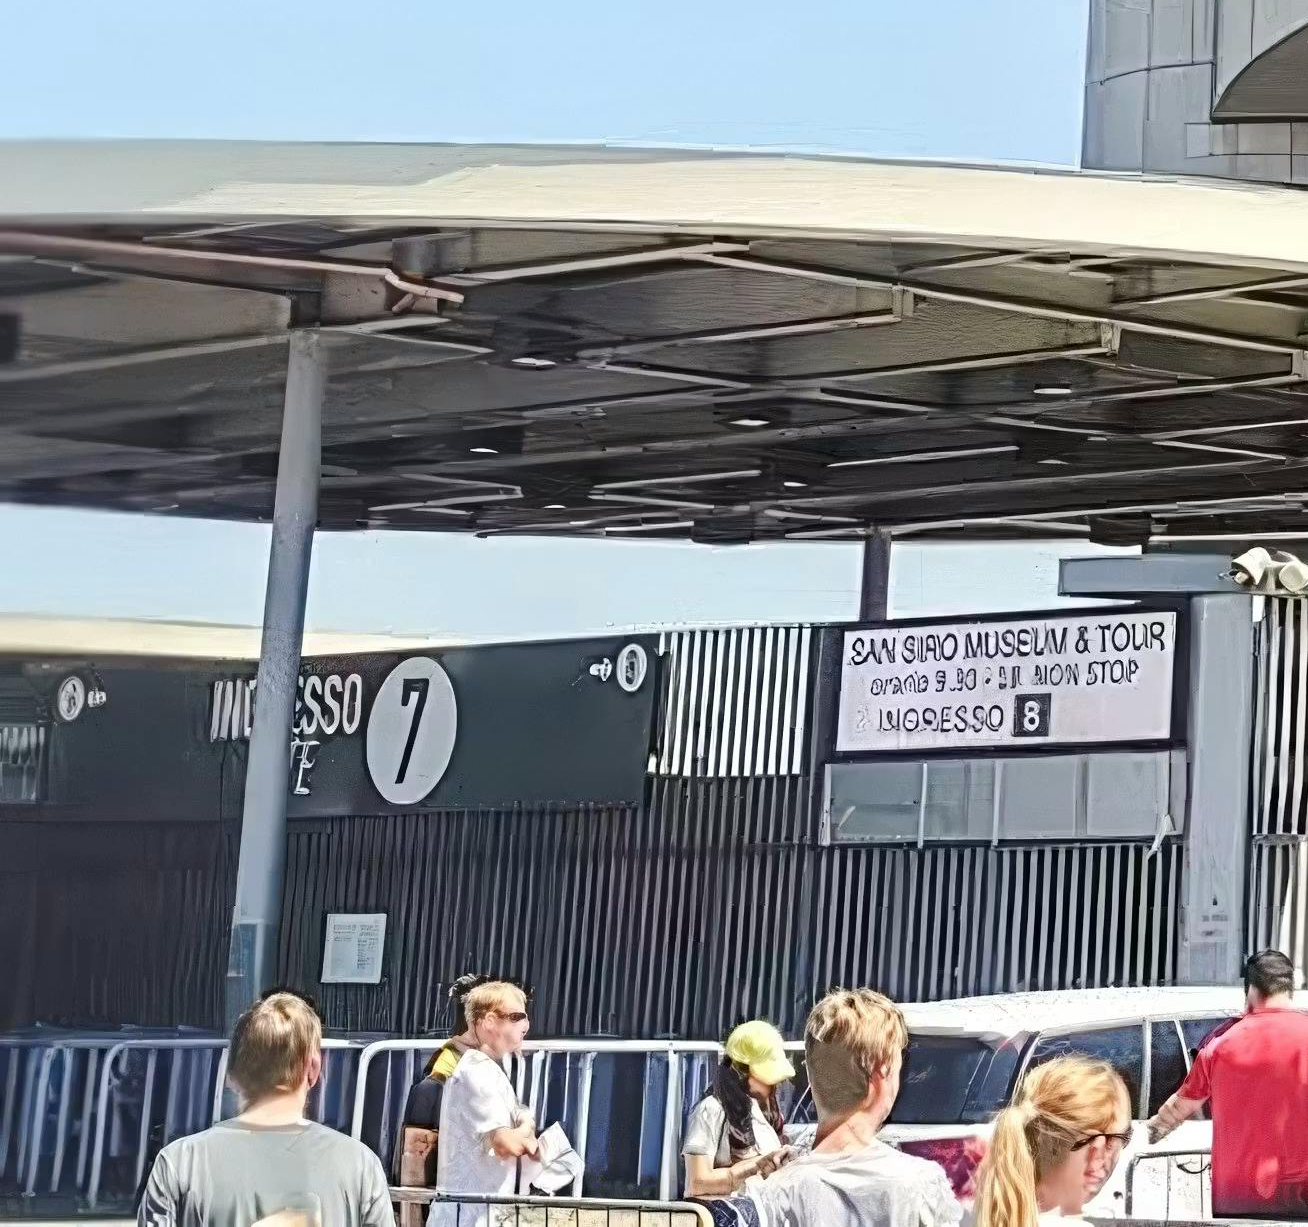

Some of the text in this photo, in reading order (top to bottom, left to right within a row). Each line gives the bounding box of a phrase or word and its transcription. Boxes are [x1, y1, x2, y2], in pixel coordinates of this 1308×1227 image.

[1075, 626, 1091, 654] &
[1098, 621, 1166, 653] TOUR
[1086, 657, 1139, 686] STOP
[395, 678, 430, 784] 7
[1023, 700, 1041, 732] 8
